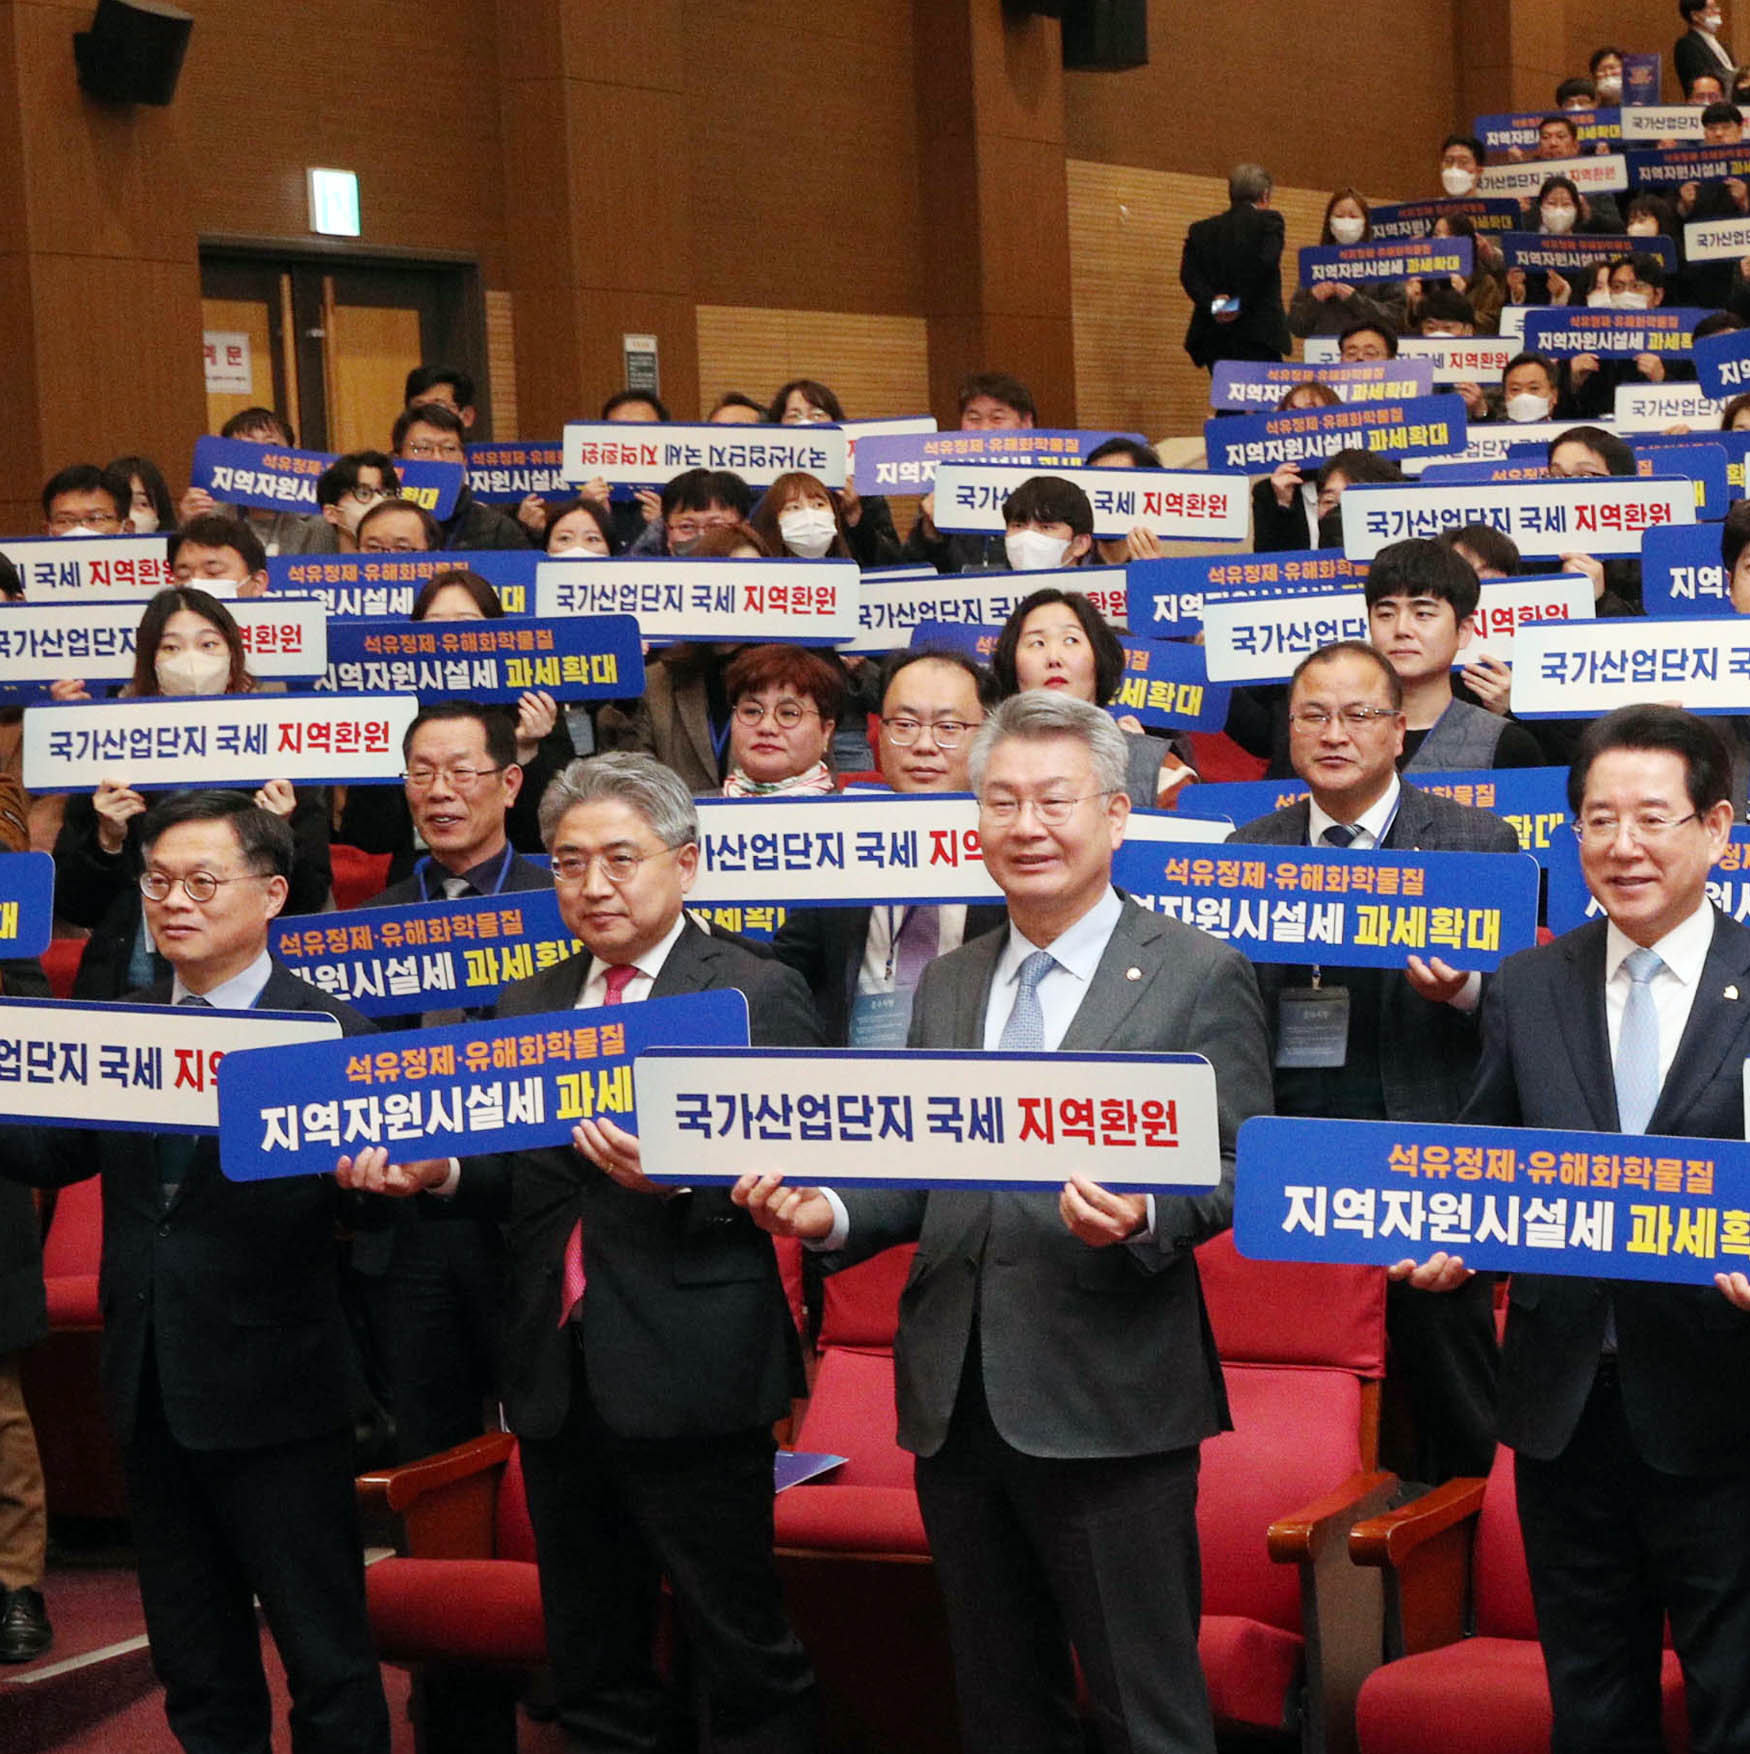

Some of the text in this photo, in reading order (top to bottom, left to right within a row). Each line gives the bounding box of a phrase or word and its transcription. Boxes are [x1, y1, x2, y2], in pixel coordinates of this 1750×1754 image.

[1224, 431, 1363, 469] 지역자원시설세
[1367, 422, 1449, 452] 과세확대
[210, 465, 318, 502] 지역자원시
[465, 469, 571, 495] 자원시설세
[1093, 489, 1229, 519] 국세 지역환원
[1519, 507, 1568, 536] 국세
[1574, 502, 1673, 534] 지역환원
[34, 562, 81, 588] 국세
[556, 583, 837, 616] 국가산업단지 국세 지역환원
[858, 597, 994, 629] 국가산업단지
[1230, 615, 1367, 657] 국가산업단
[314, 653, 619, 693] 지역자원시설세 과세확대
[1540, 647, 1719, 687] 국가산업단지
[1112, 675, 1206, 719] 세확대
[48, 719, 391, 762] 국가산업단지 국세 지역환원
[704, 827, 982, 874] 산업단지 국세 지역
[1502, 810, 1565, 849] 확대
[1163, 856, 1426, 897] 석유정제·유해화학물질
[278, 907, 525, 959] 석유정제·유해화학물질
[1130, 894, 1502, 952] 자원시설세 과세확대
[288, 943, 457, 1001] 원시설세
[0, 1038, 89, 1086] 업단지
[97, 1043, 164, 1090] 국세
[344, 1022, 627, 1086] 석유정제·유해화학물질
[259, 1065, 635, 1153] 지역자원시설세 과세
[674, 1092, 1180, 1149] 국가산업단지 국세 지역환원
[1386, 1143, 1716, 1196] 석유정제·유해화학물질
[1281, 1184, 1616, 1253] 지역자원시설세
